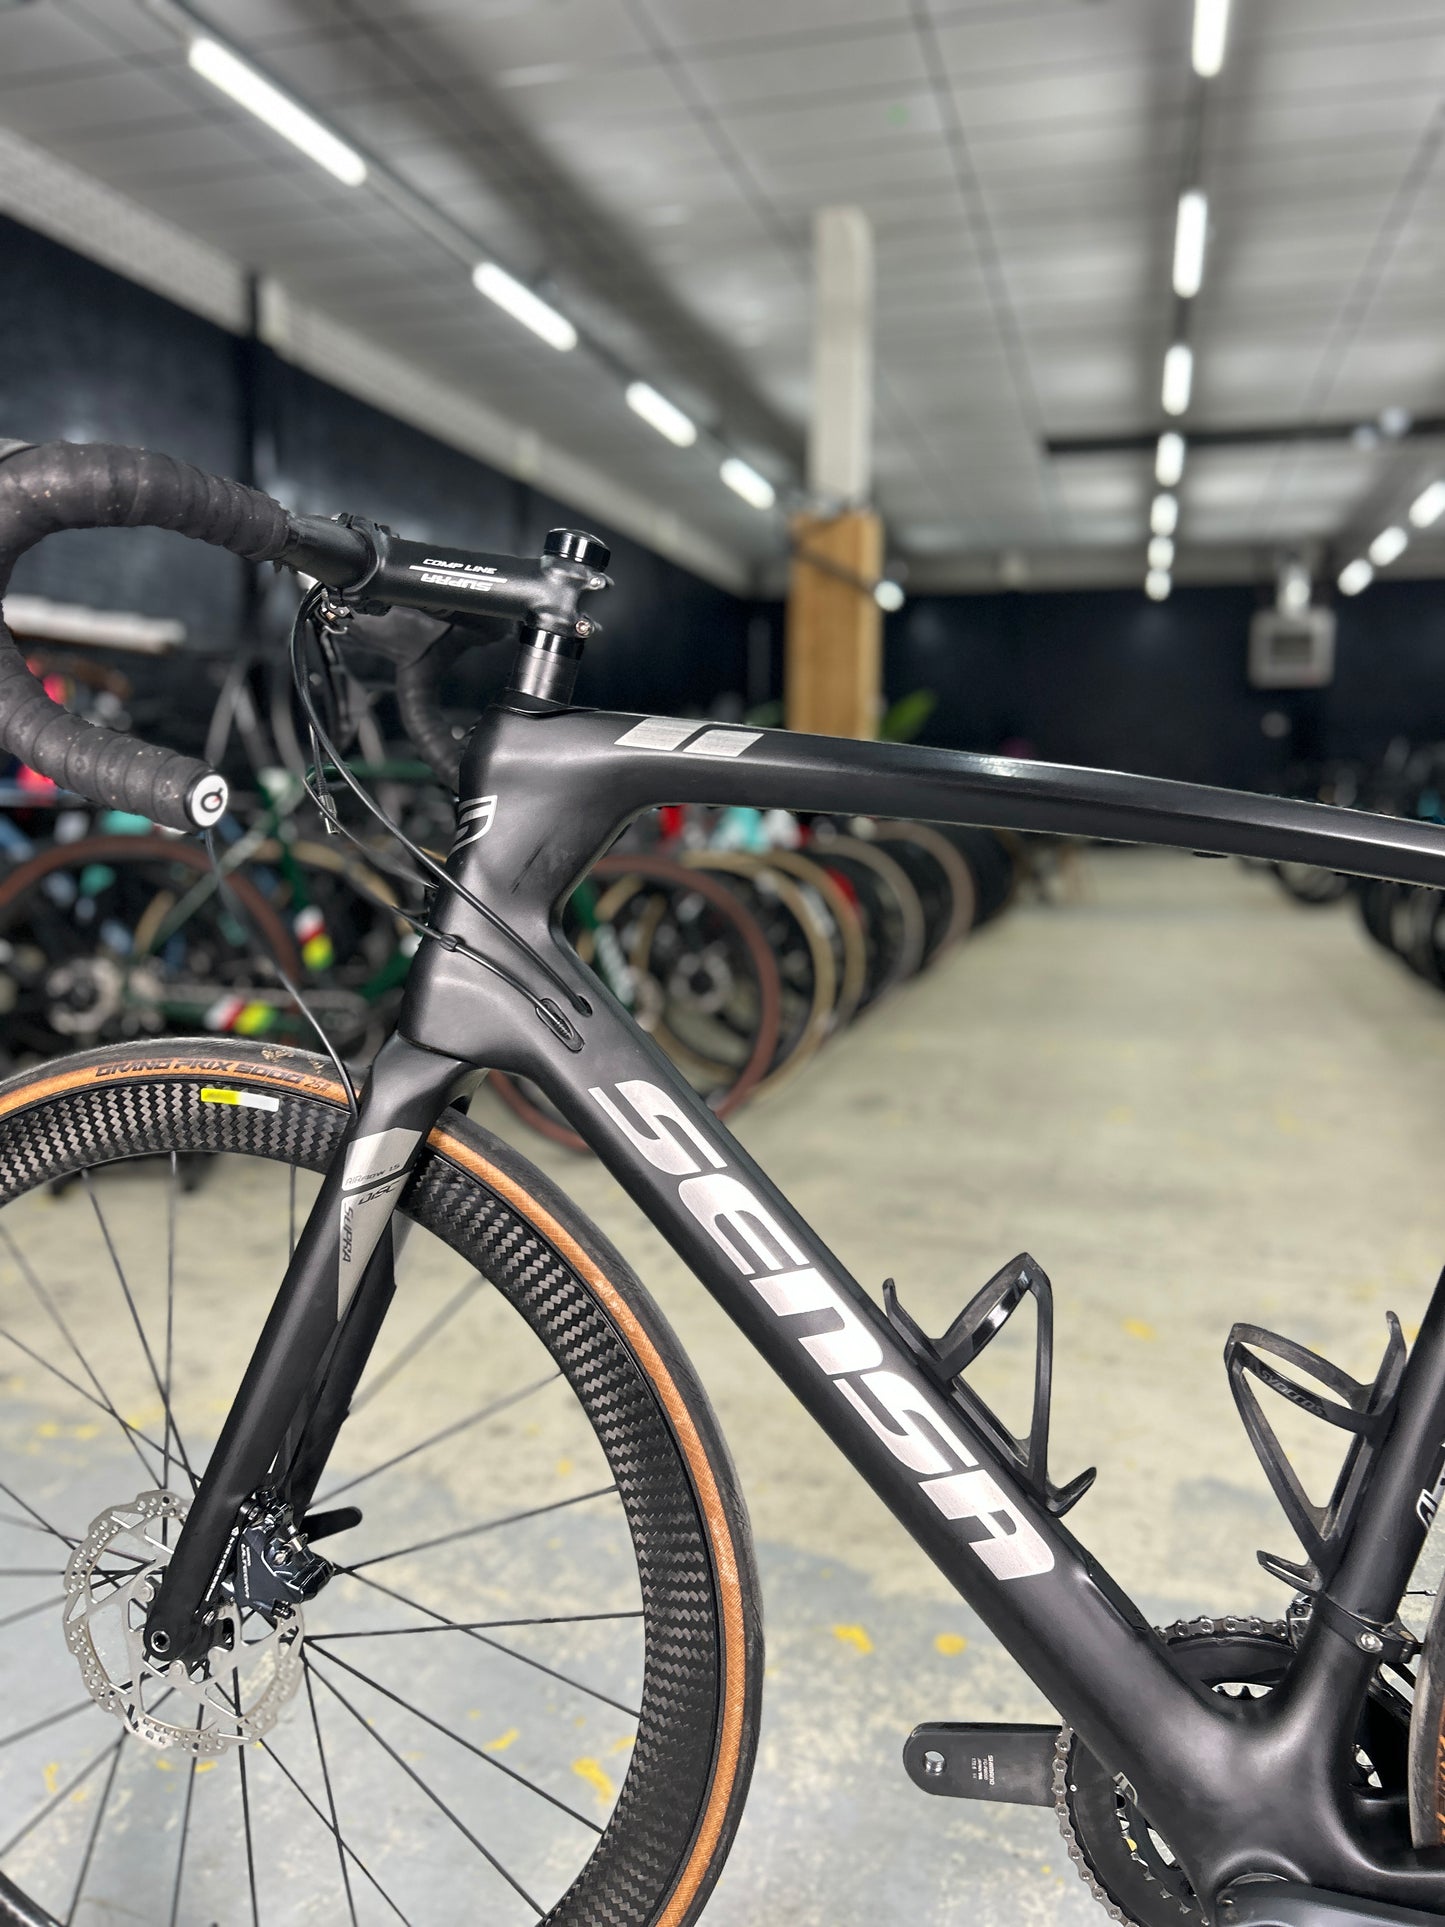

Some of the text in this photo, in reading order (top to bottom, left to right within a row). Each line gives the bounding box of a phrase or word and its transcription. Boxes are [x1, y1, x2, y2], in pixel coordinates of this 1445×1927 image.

[422, 558, 498, 574] COMP LINE
[420, 573, 494, 591] SUPRA
[95, 1060, 170, 1077] GRAND
[173, 1060, 234, 1071] PRIX
[233, 1063, 304, 1084] 5000
[342, 1203, 353, 1262] SUPRA
[588, 1080, 1055, 1580] SENSA
